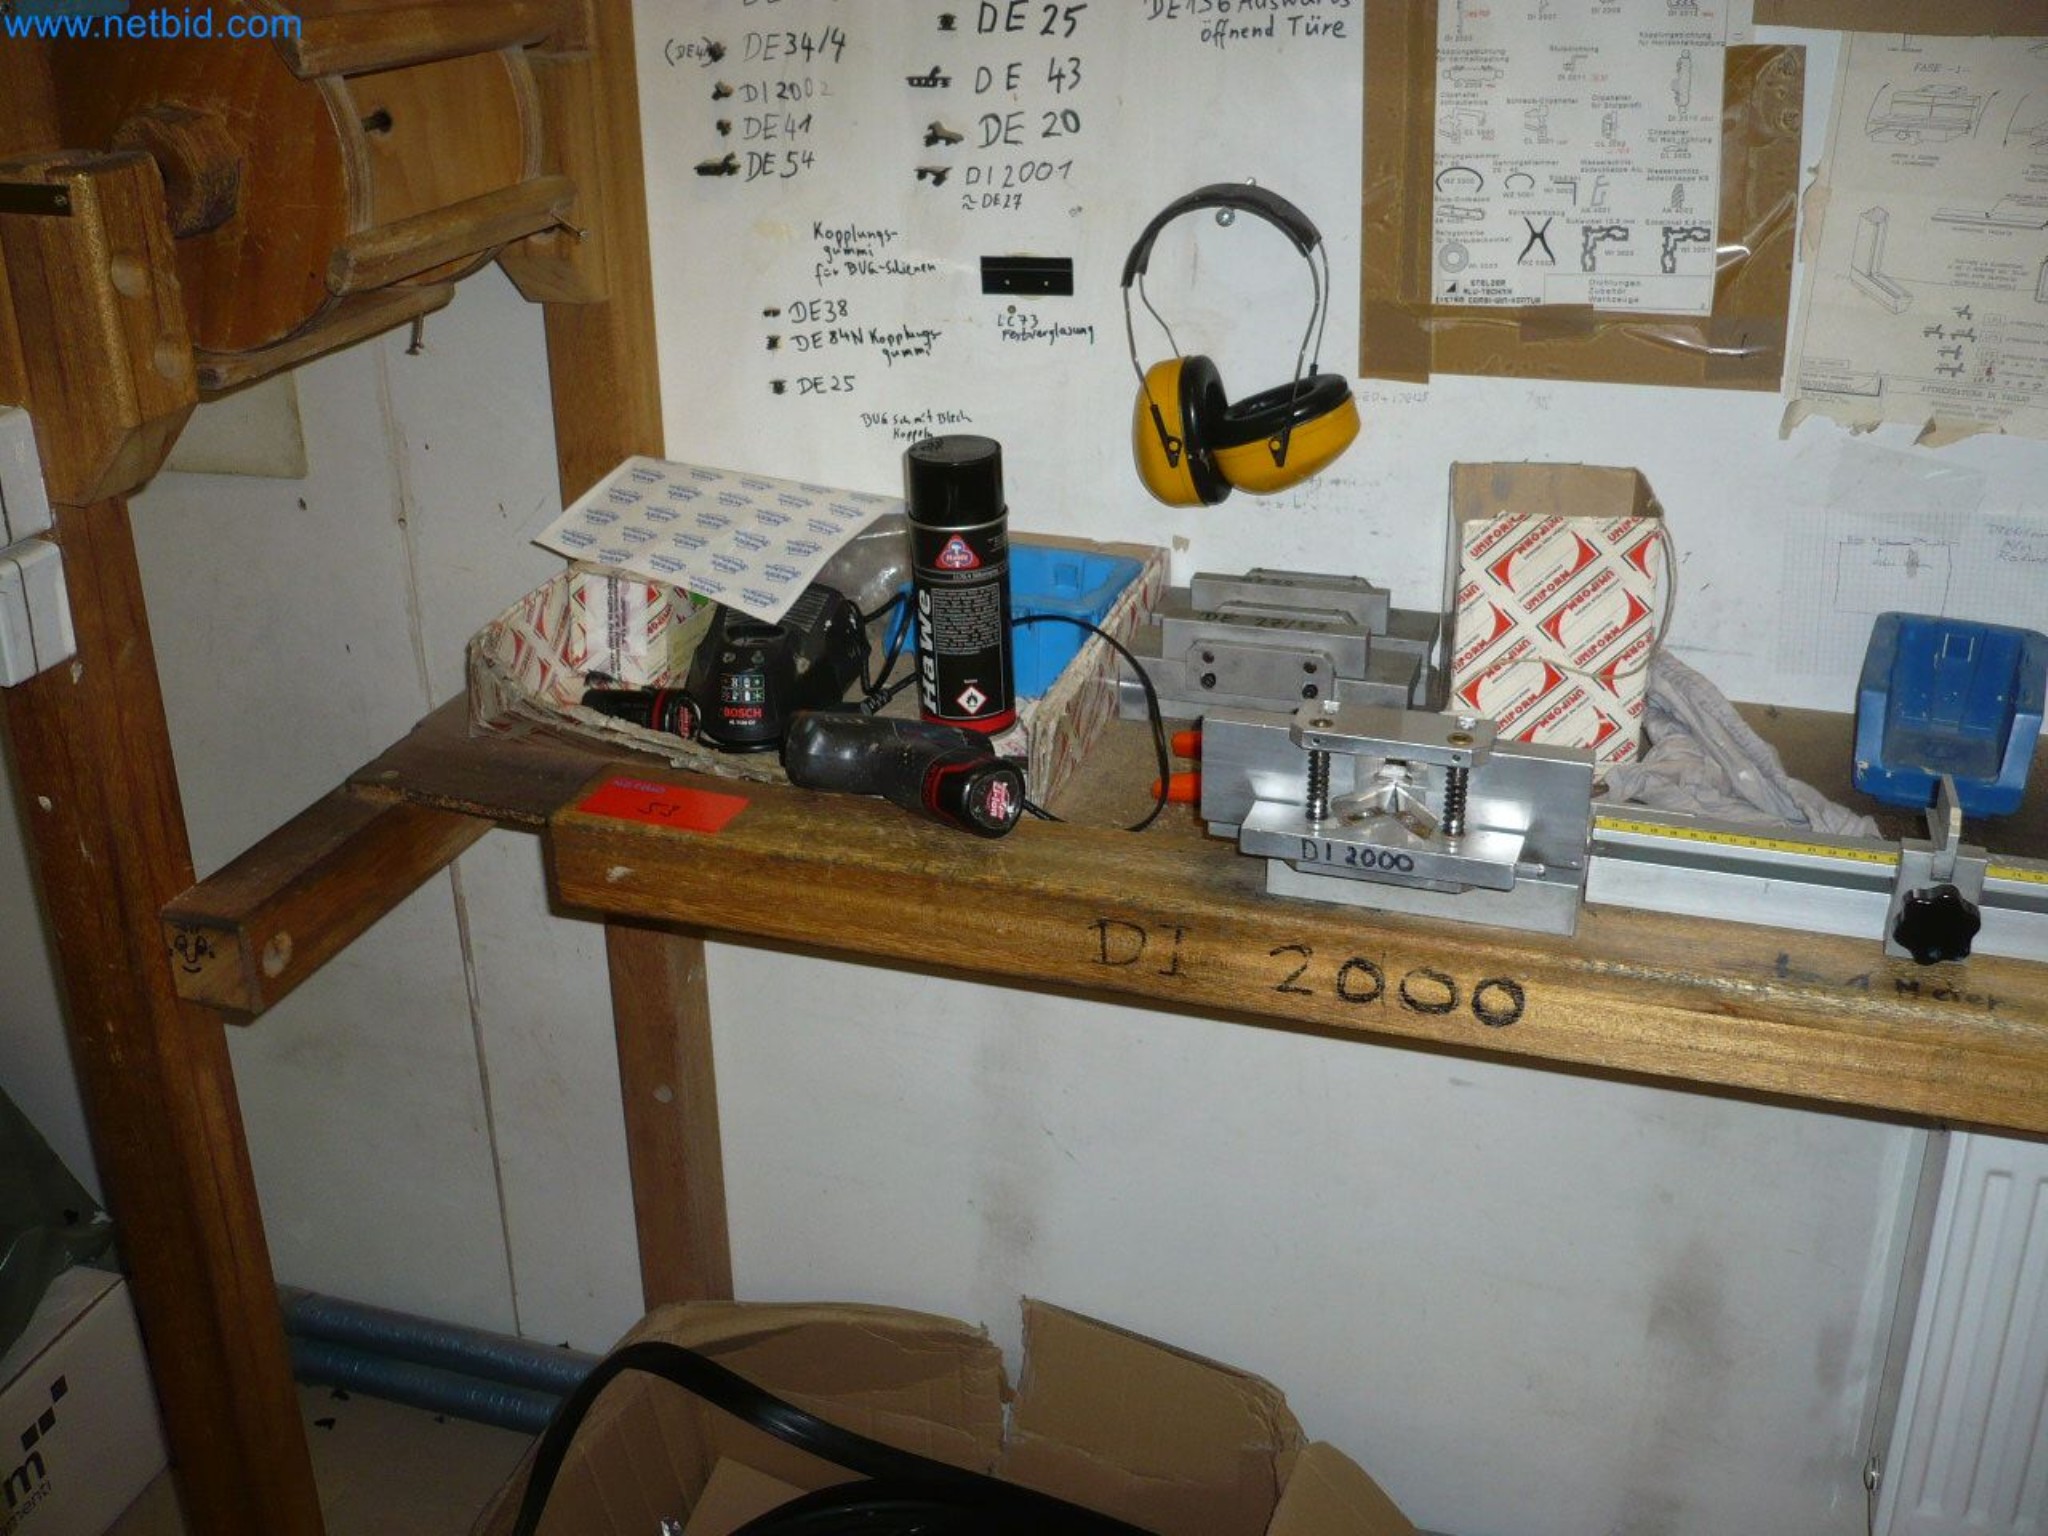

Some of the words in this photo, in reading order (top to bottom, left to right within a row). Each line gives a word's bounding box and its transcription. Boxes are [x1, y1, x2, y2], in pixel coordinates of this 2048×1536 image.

[1039, 3, 1088, 38] 25
[1201, 15, 1275, 49] öffnend
[1288, 15, 1348, 39] Türe
[723, 706, 763, 718] BOSCH
[1345, 847, 1415, 872] 2000
[1269, 943, 1526, 1029] 2000
